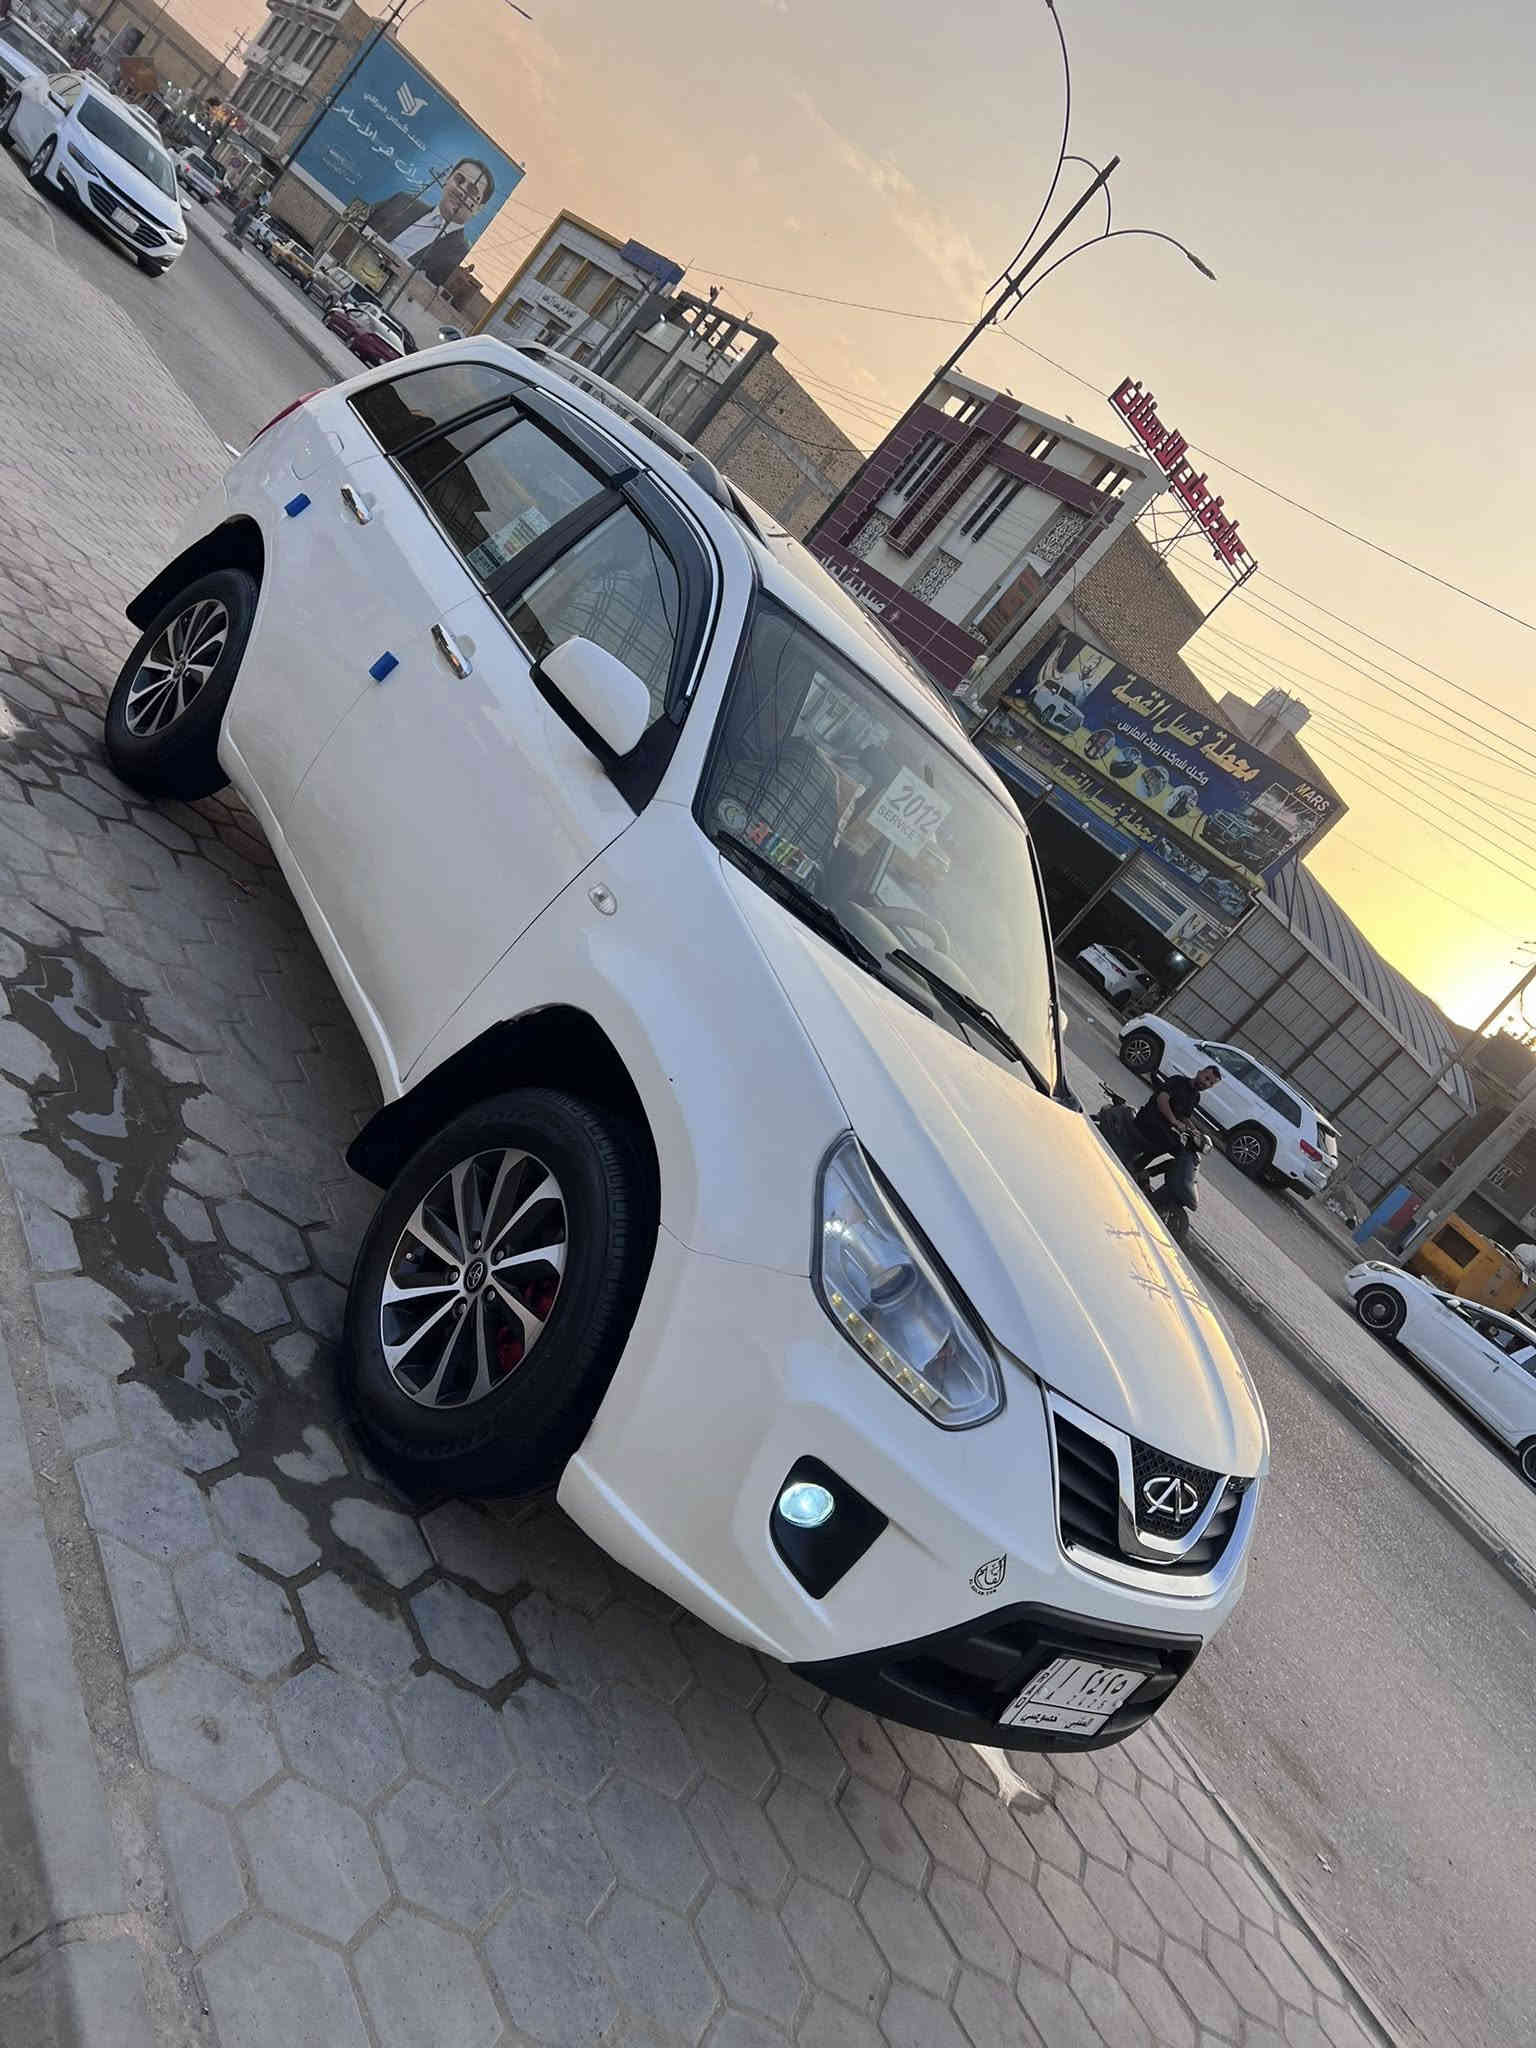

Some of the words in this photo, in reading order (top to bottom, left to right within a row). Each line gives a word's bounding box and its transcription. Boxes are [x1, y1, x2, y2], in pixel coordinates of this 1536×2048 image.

[1168, 458, 1209, 512] طب
[1111, 674, 1173, 721] القمة
[1153, 712, 1210, 747] غسل
[1200, 731, 1262, 783] محطة
[887, 785, 942, 832] 2012
[1294, 782, 1333, 812] MARS
[878, 803, 918, 841] SERVICE
[1119, 806, 1157, 842] محطة
